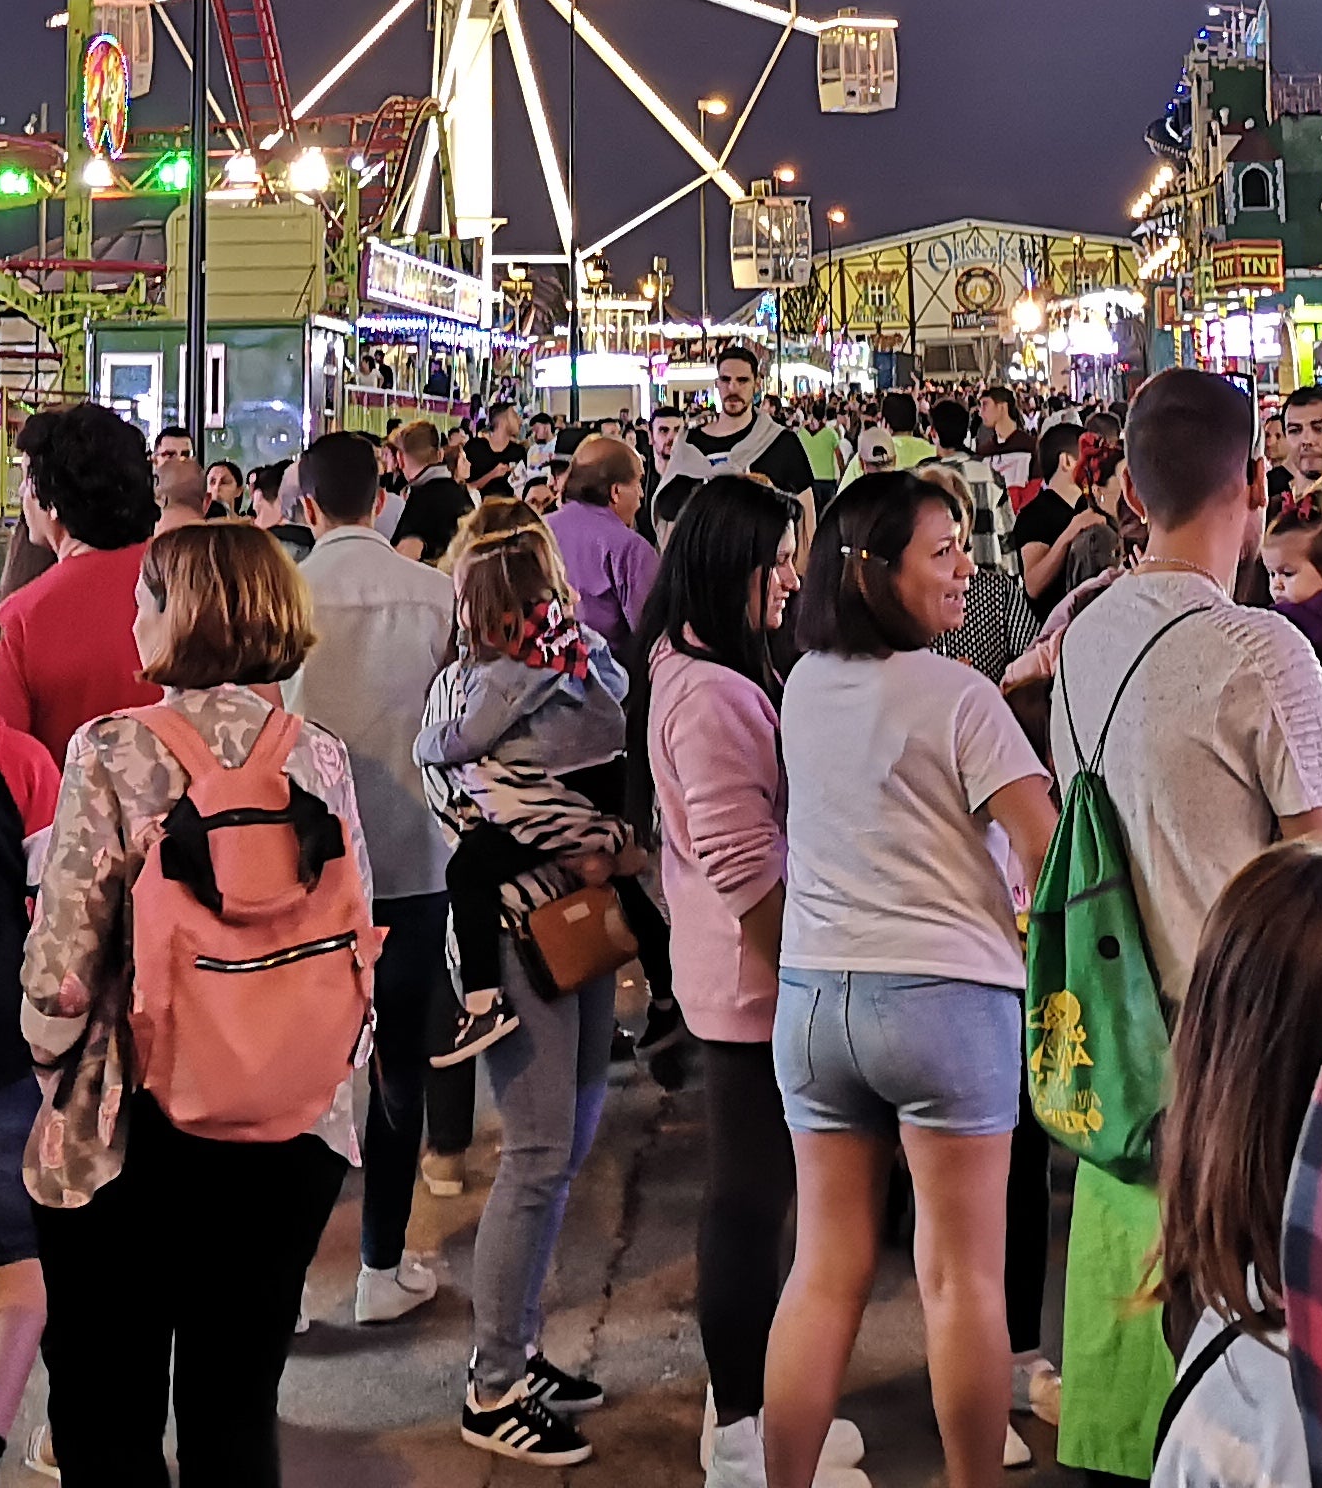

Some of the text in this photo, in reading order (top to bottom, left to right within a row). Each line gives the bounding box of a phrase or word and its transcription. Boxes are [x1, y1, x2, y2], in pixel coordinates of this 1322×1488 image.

[927, 235, 1029, 273] Oktoberfes
[1214, 256, 1278, 278] TNT TNT
